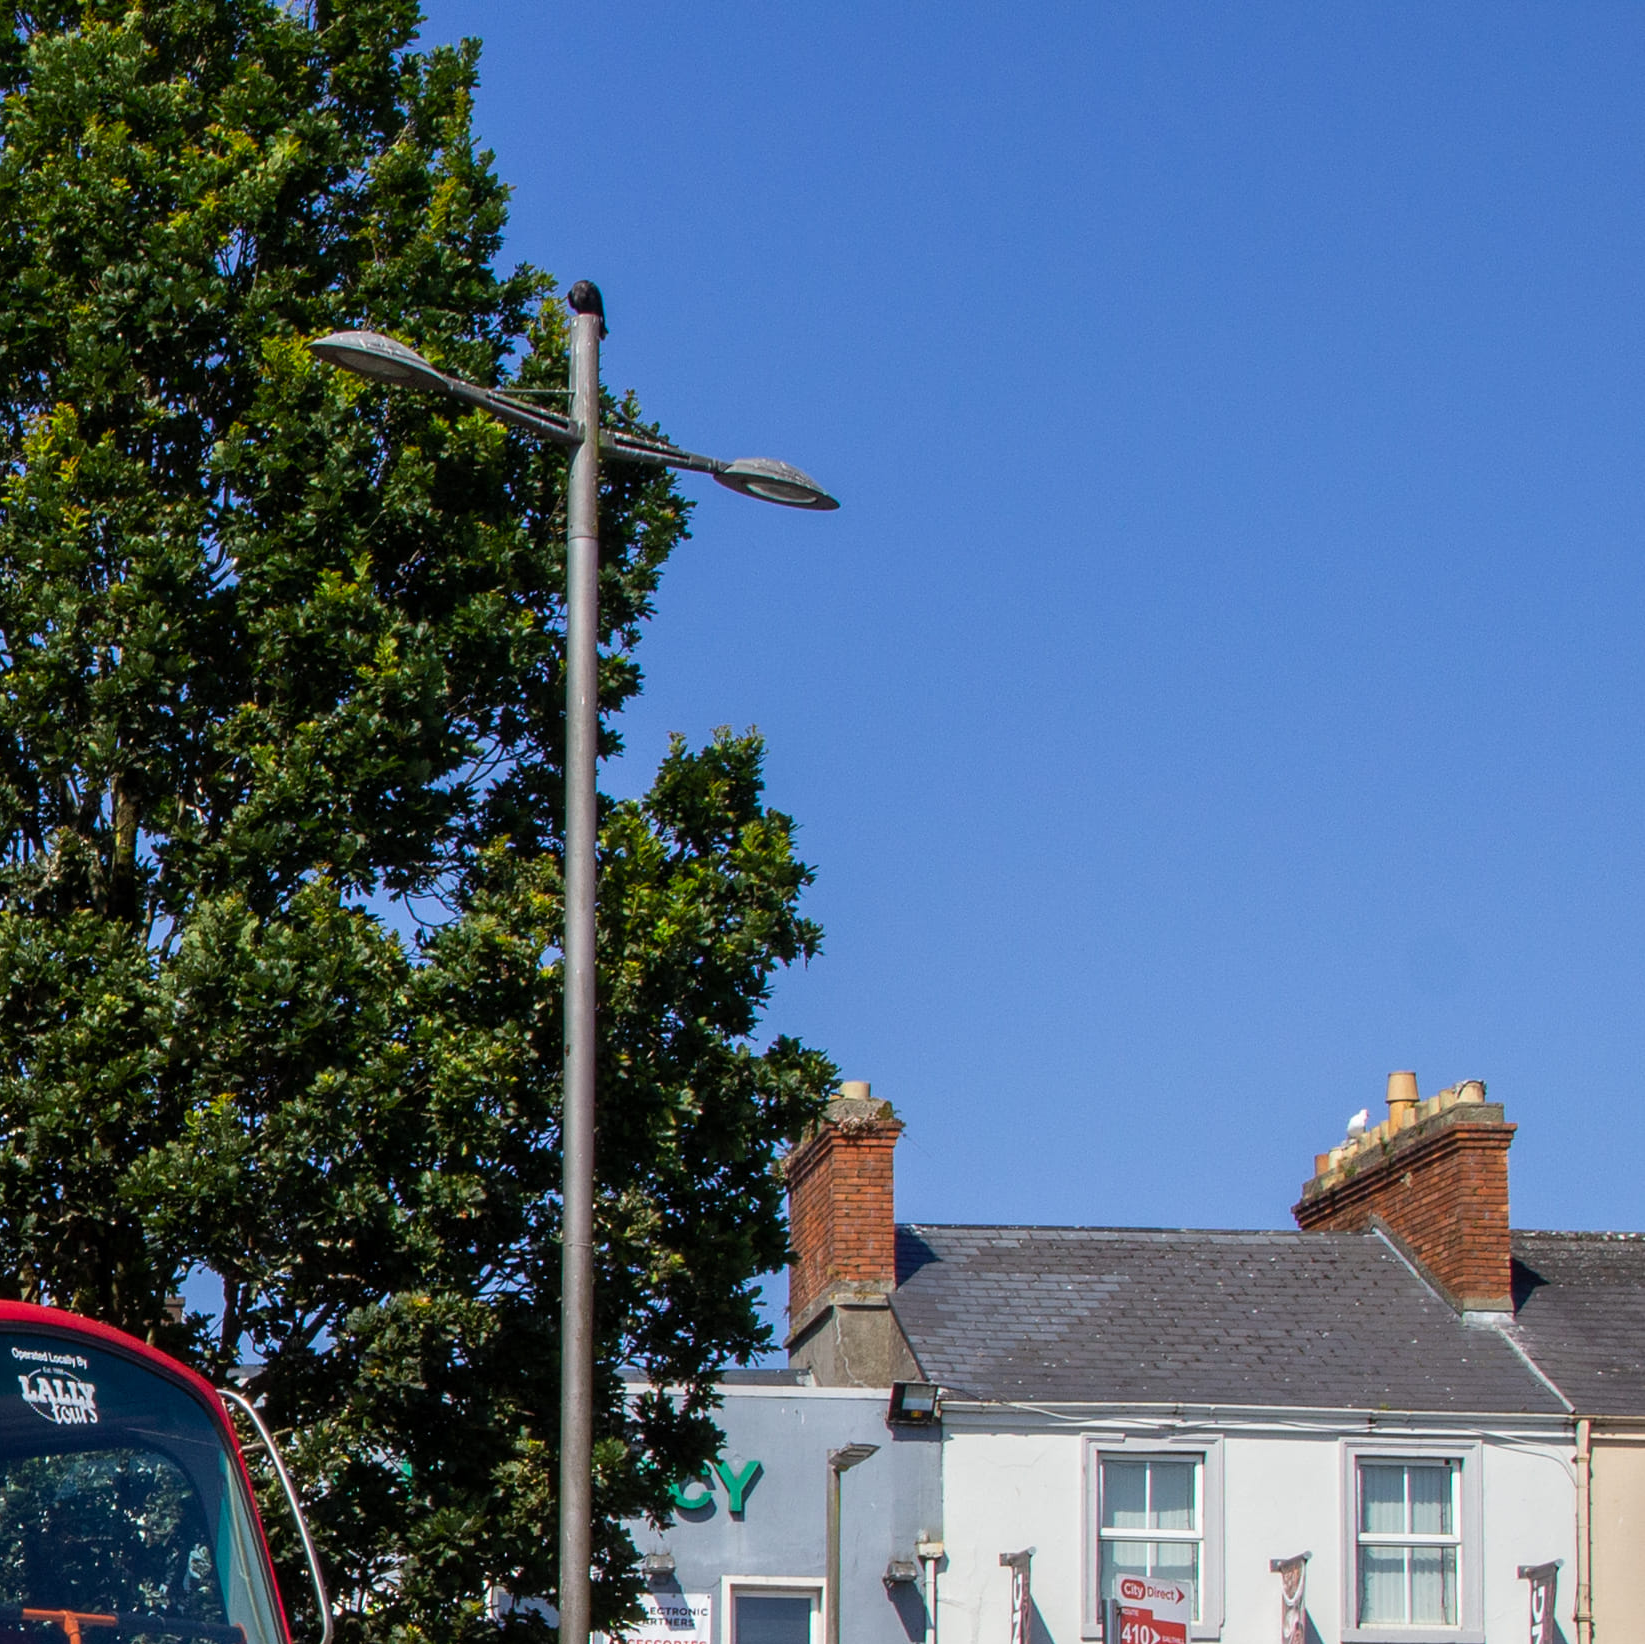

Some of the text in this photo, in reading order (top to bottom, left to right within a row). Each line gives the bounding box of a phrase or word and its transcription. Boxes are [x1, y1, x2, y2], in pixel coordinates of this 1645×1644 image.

[11, 1347, 88, 1370] Operated Locally By
[18, 1375, 96, 1408] LALLY
[51, 1401, 98, 1424] tours
[1123, 1582, 1175, 1601] City Direct
